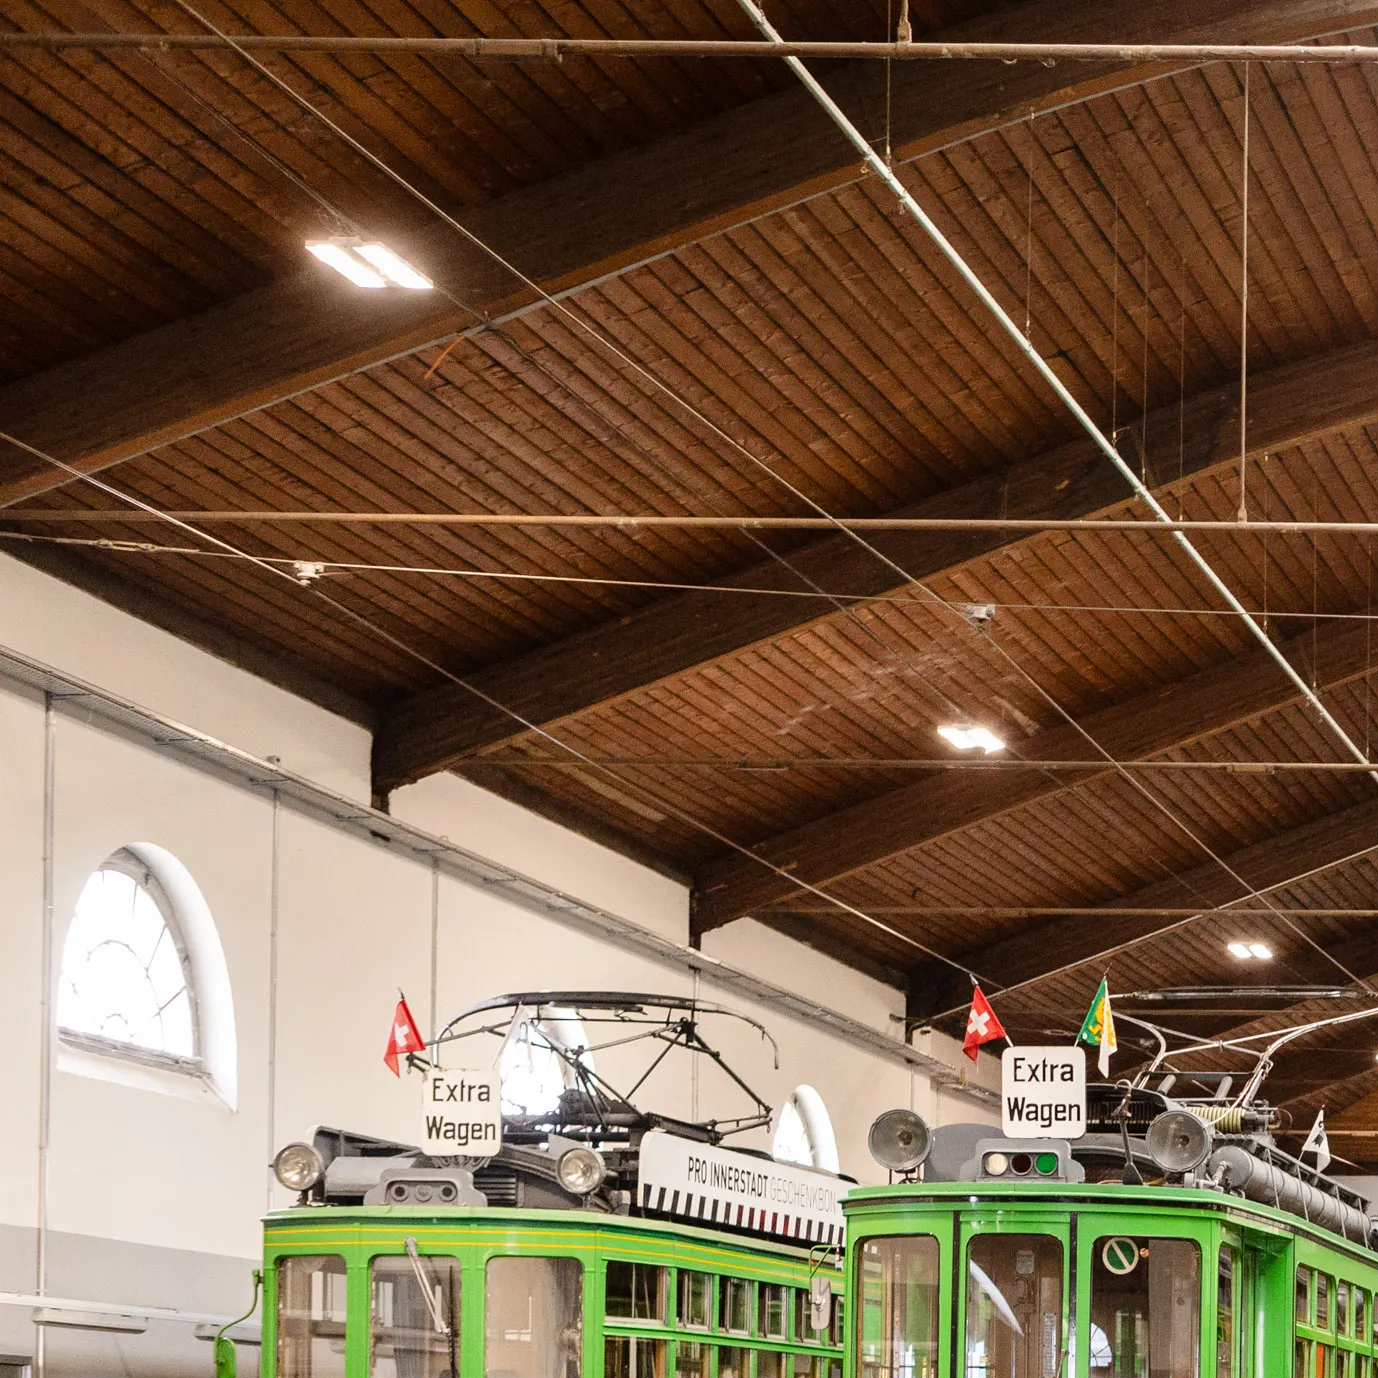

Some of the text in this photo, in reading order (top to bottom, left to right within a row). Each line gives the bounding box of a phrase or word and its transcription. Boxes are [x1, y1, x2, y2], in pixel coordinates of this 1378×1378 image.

[1013, 1056, 1074, 1082] Extra
[432, 1077, 490, 1102] Extra
[1007, 1096, 1081, 1128] Wagen
[426, 1115, 496, 1146] Wagen
[687, 1156, 836, 1214] PRO INNERSTADT GESCHENKBON
